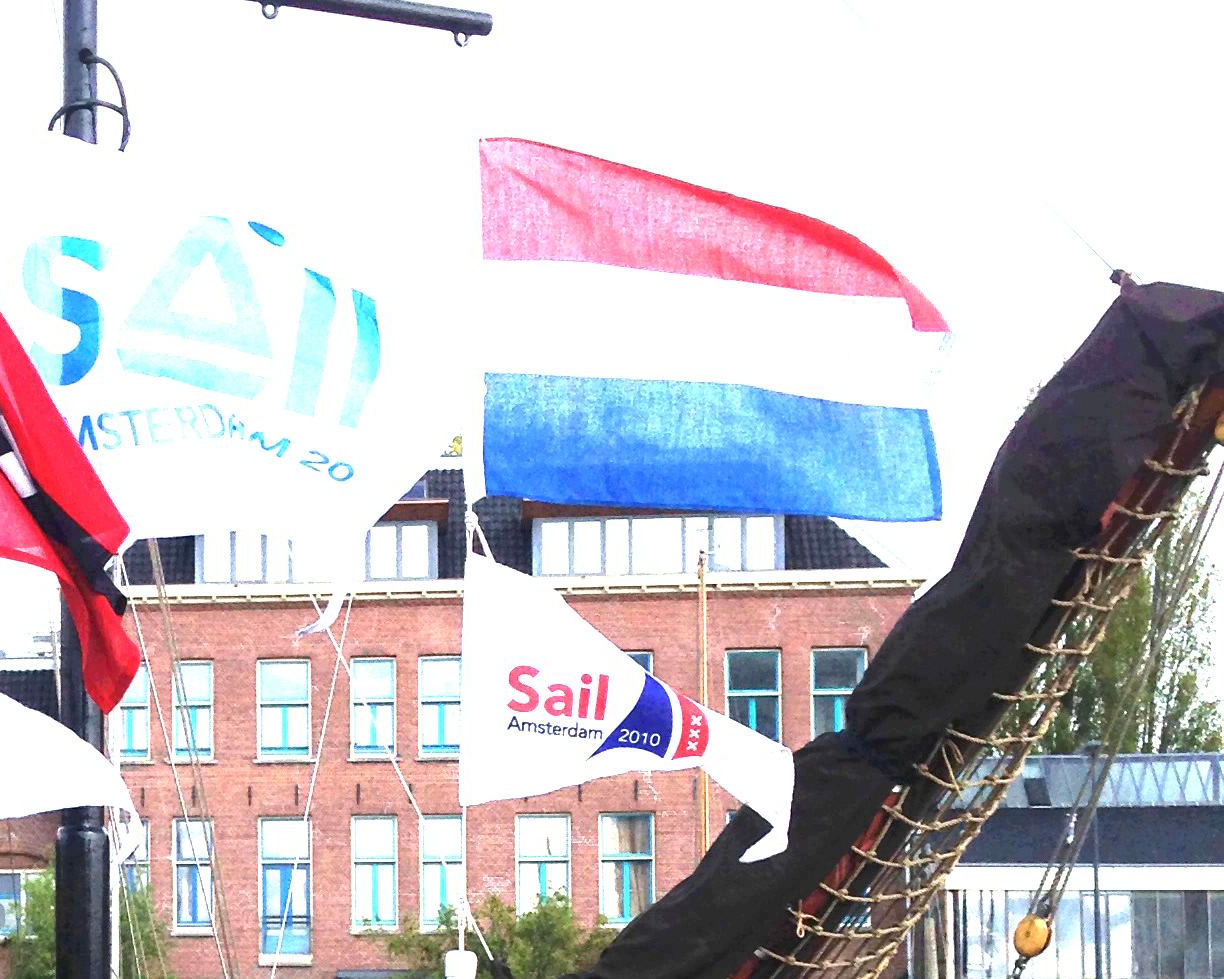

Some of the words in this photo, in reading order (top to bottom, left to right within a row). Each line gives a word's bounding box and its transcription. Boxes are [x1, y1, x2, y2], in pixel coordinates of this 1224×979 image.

[76, 403, 291, 458] MSTERDAM
[506, 665, 609, 721] Sail
[507, 716, 603, 740] Amsterdam
[618, 728, 661, 747] 2010
